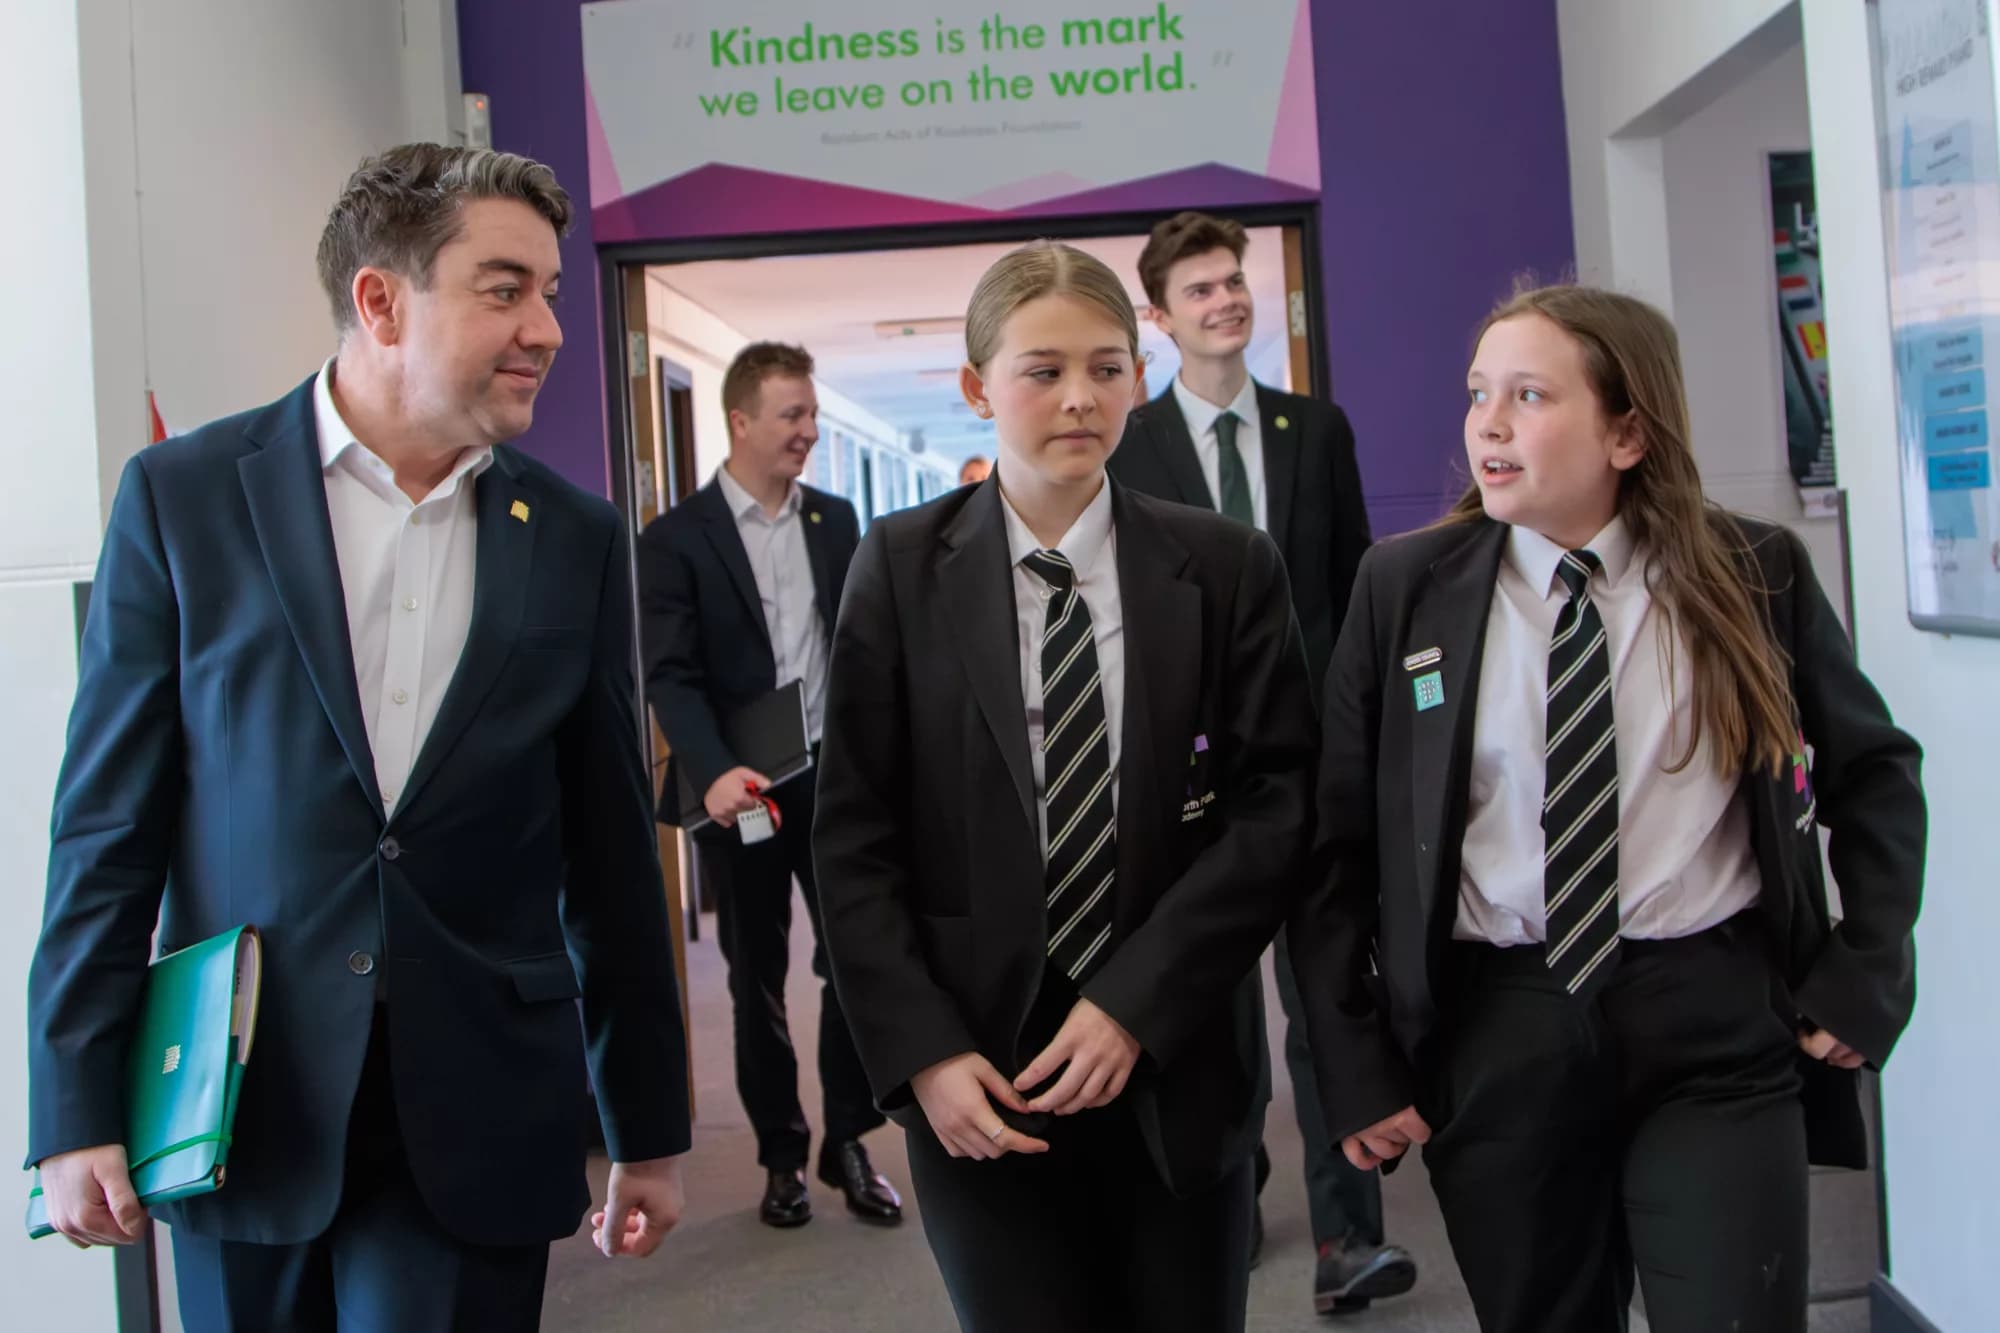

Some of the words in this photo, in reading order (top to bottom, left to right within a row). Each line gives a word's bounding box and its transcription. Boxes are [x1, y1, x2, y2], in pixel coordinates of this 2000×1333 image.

[710, 22, 921, 69] Kindness
[936, 17, 966, 55] is
[979, 12, 1046, 53] the
[1061, 1, 1184, 48] mark
[698, 91, 759, 118] we
[774, 76, 885, 114] leave
[899, 80, 953, 107] on
[967, 63, 1034, 103] the
[1048, 50, 1196, 97] world.
